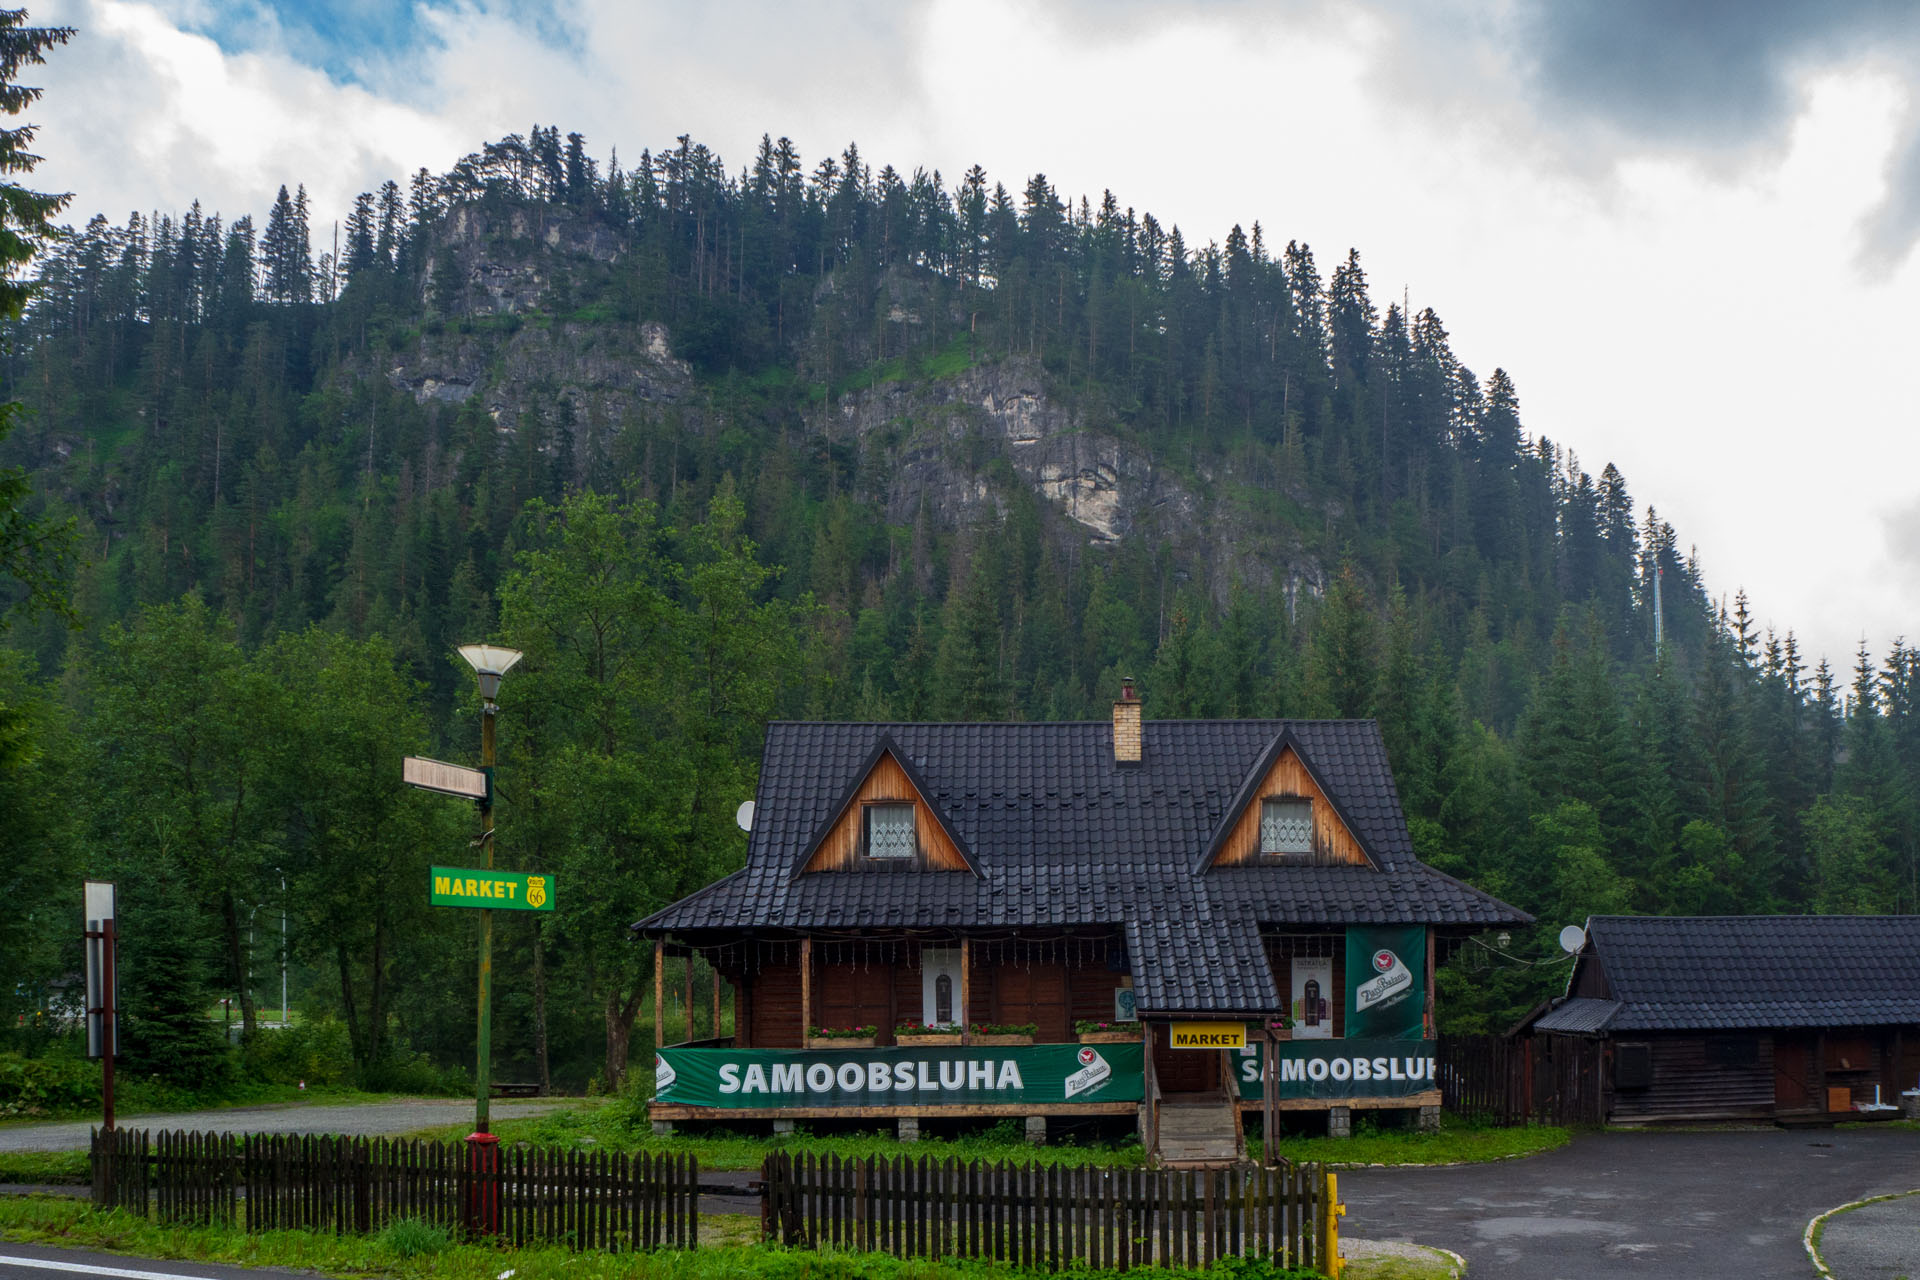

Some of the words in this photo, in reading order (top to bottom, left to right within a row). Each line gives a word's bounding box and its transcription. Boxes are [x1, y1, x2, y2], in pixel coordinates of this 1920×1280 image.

[435, 876, 518, 899] MARKET
[530, 889, 543, 904] 66
[1176, 1034, 1240, 1045] MARKET
[718, 1060, 1024, 1094] SAMOOBSLUHA
